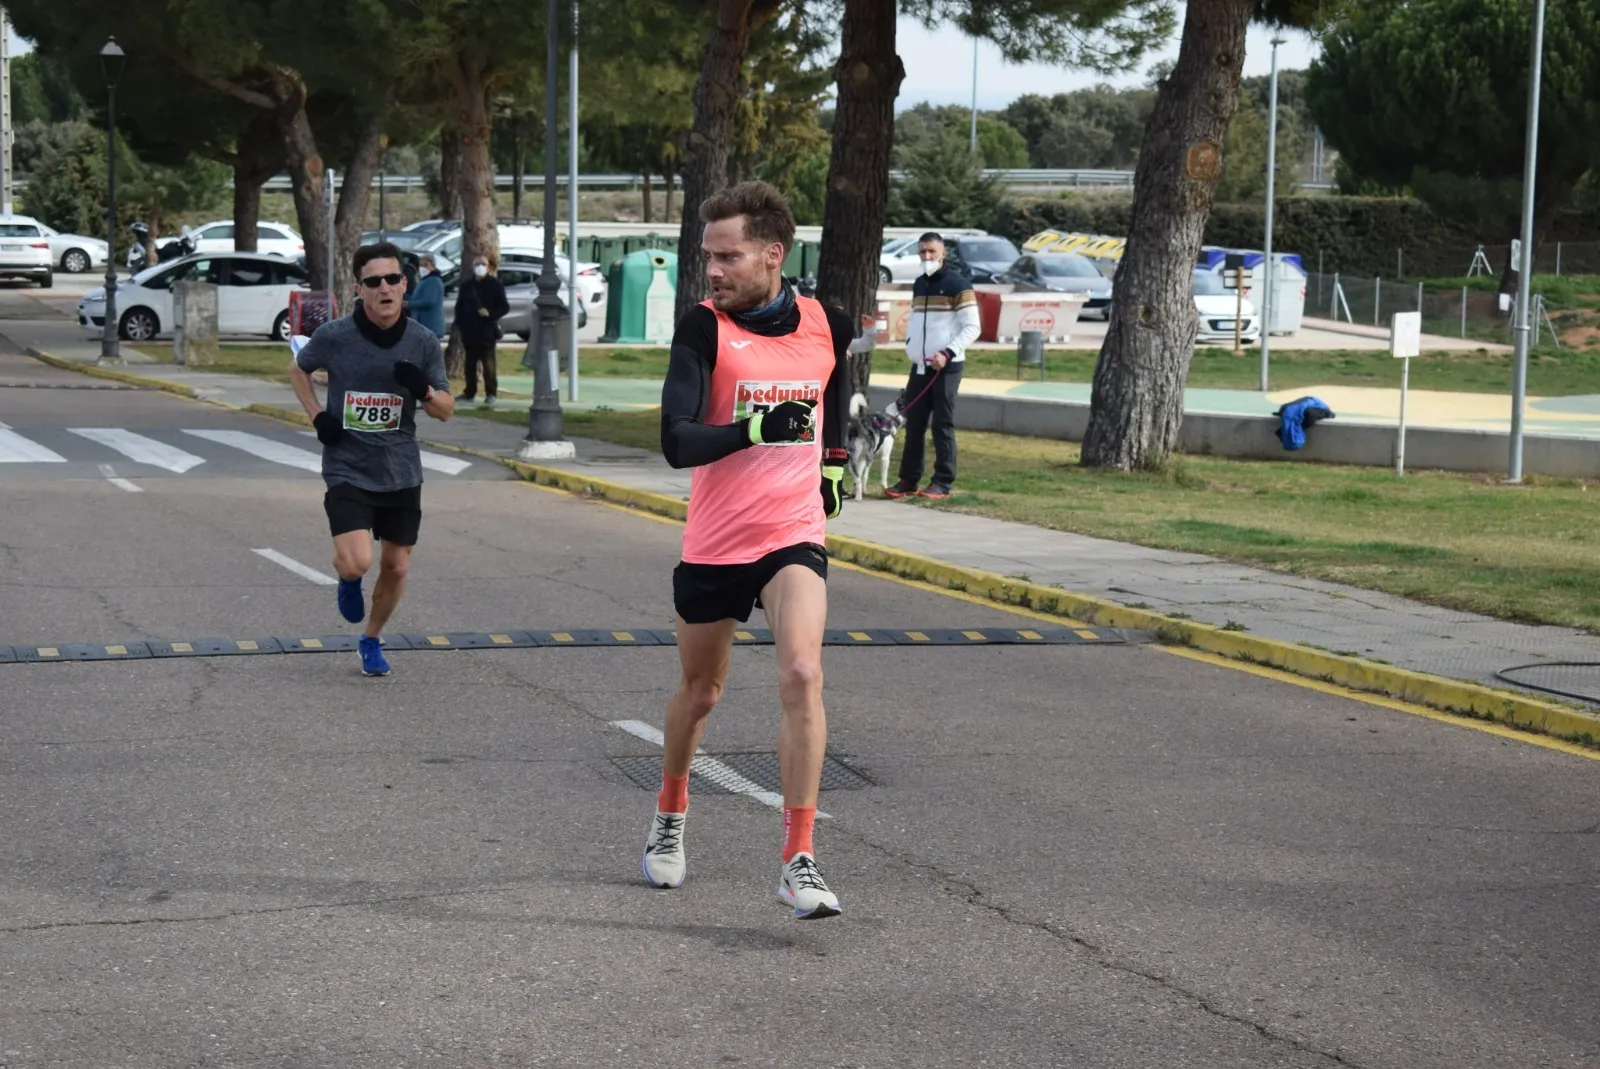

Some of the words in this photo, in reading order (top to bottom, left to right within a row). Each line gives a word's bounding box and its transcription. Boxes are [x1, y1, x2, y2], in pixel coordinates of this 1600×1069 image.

[346, 392, 402, 407] bedunia
[737, 384, 820, 404] bedunia
[355, 406, 391, 422] 788
